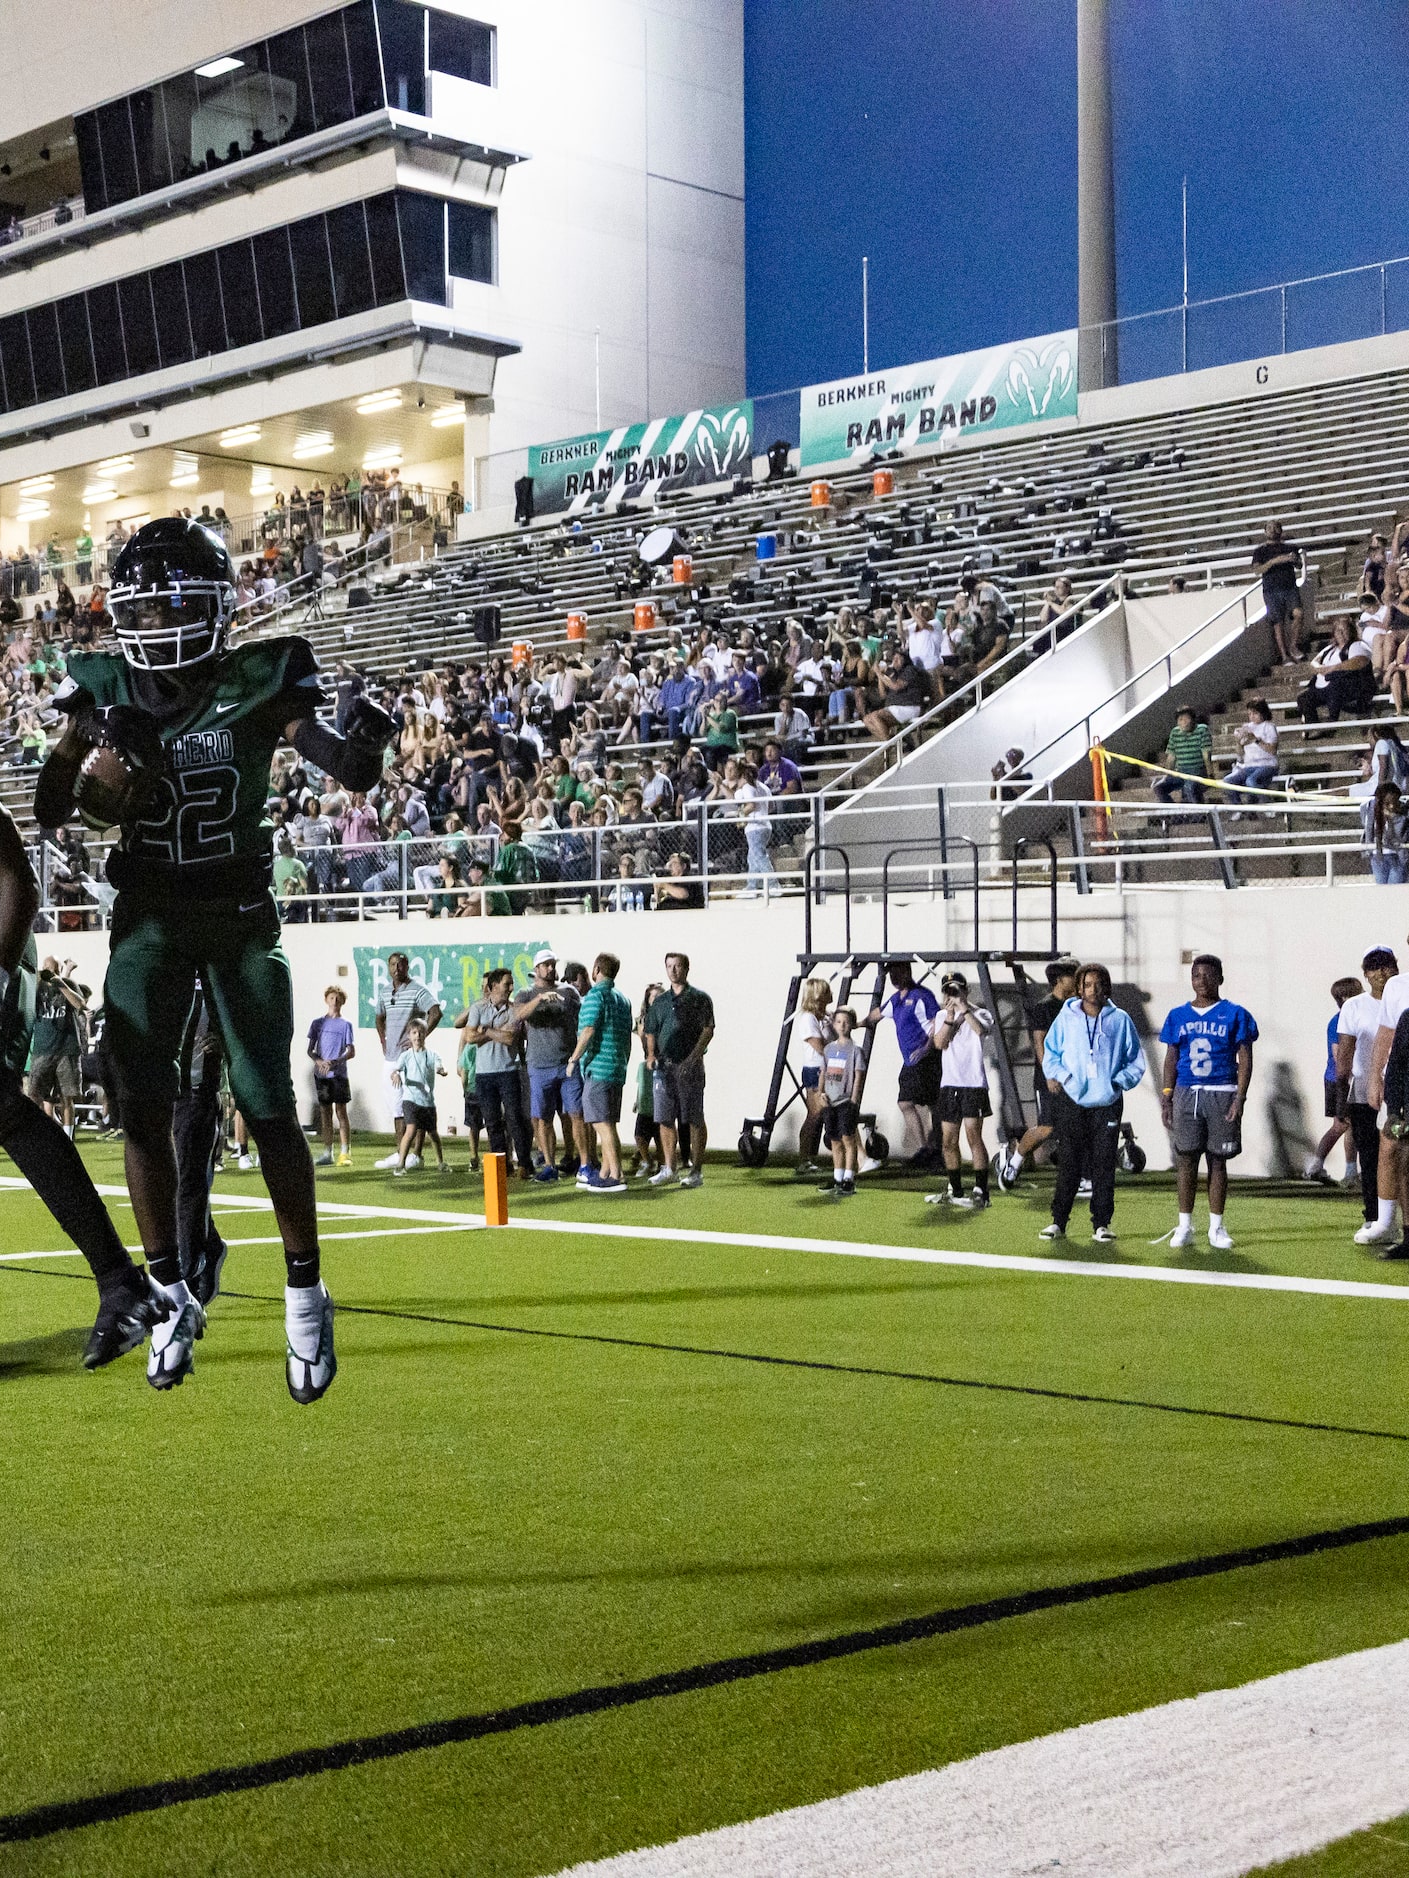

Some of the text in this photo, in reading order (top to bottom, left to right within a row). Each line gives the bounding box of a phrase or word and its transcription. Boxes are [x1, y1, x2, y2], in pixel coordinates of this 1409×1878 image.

[817, 379, 936, 408] BERKNER MIGHTY
[1256, 365, 1269, 384] G
[846, 395, 998, 449] RAM BAND
[540, 441, 642, 465] BERKNER MIGHTY
[564, 450, 690, 499] RAM BAND
[172, 729, 235, 769] HERD
[126, 765, 240, 865] 22
[1178, 1021, 1228, 1038] APOLLO
[1188, 1037, 1213, 1077] 6
